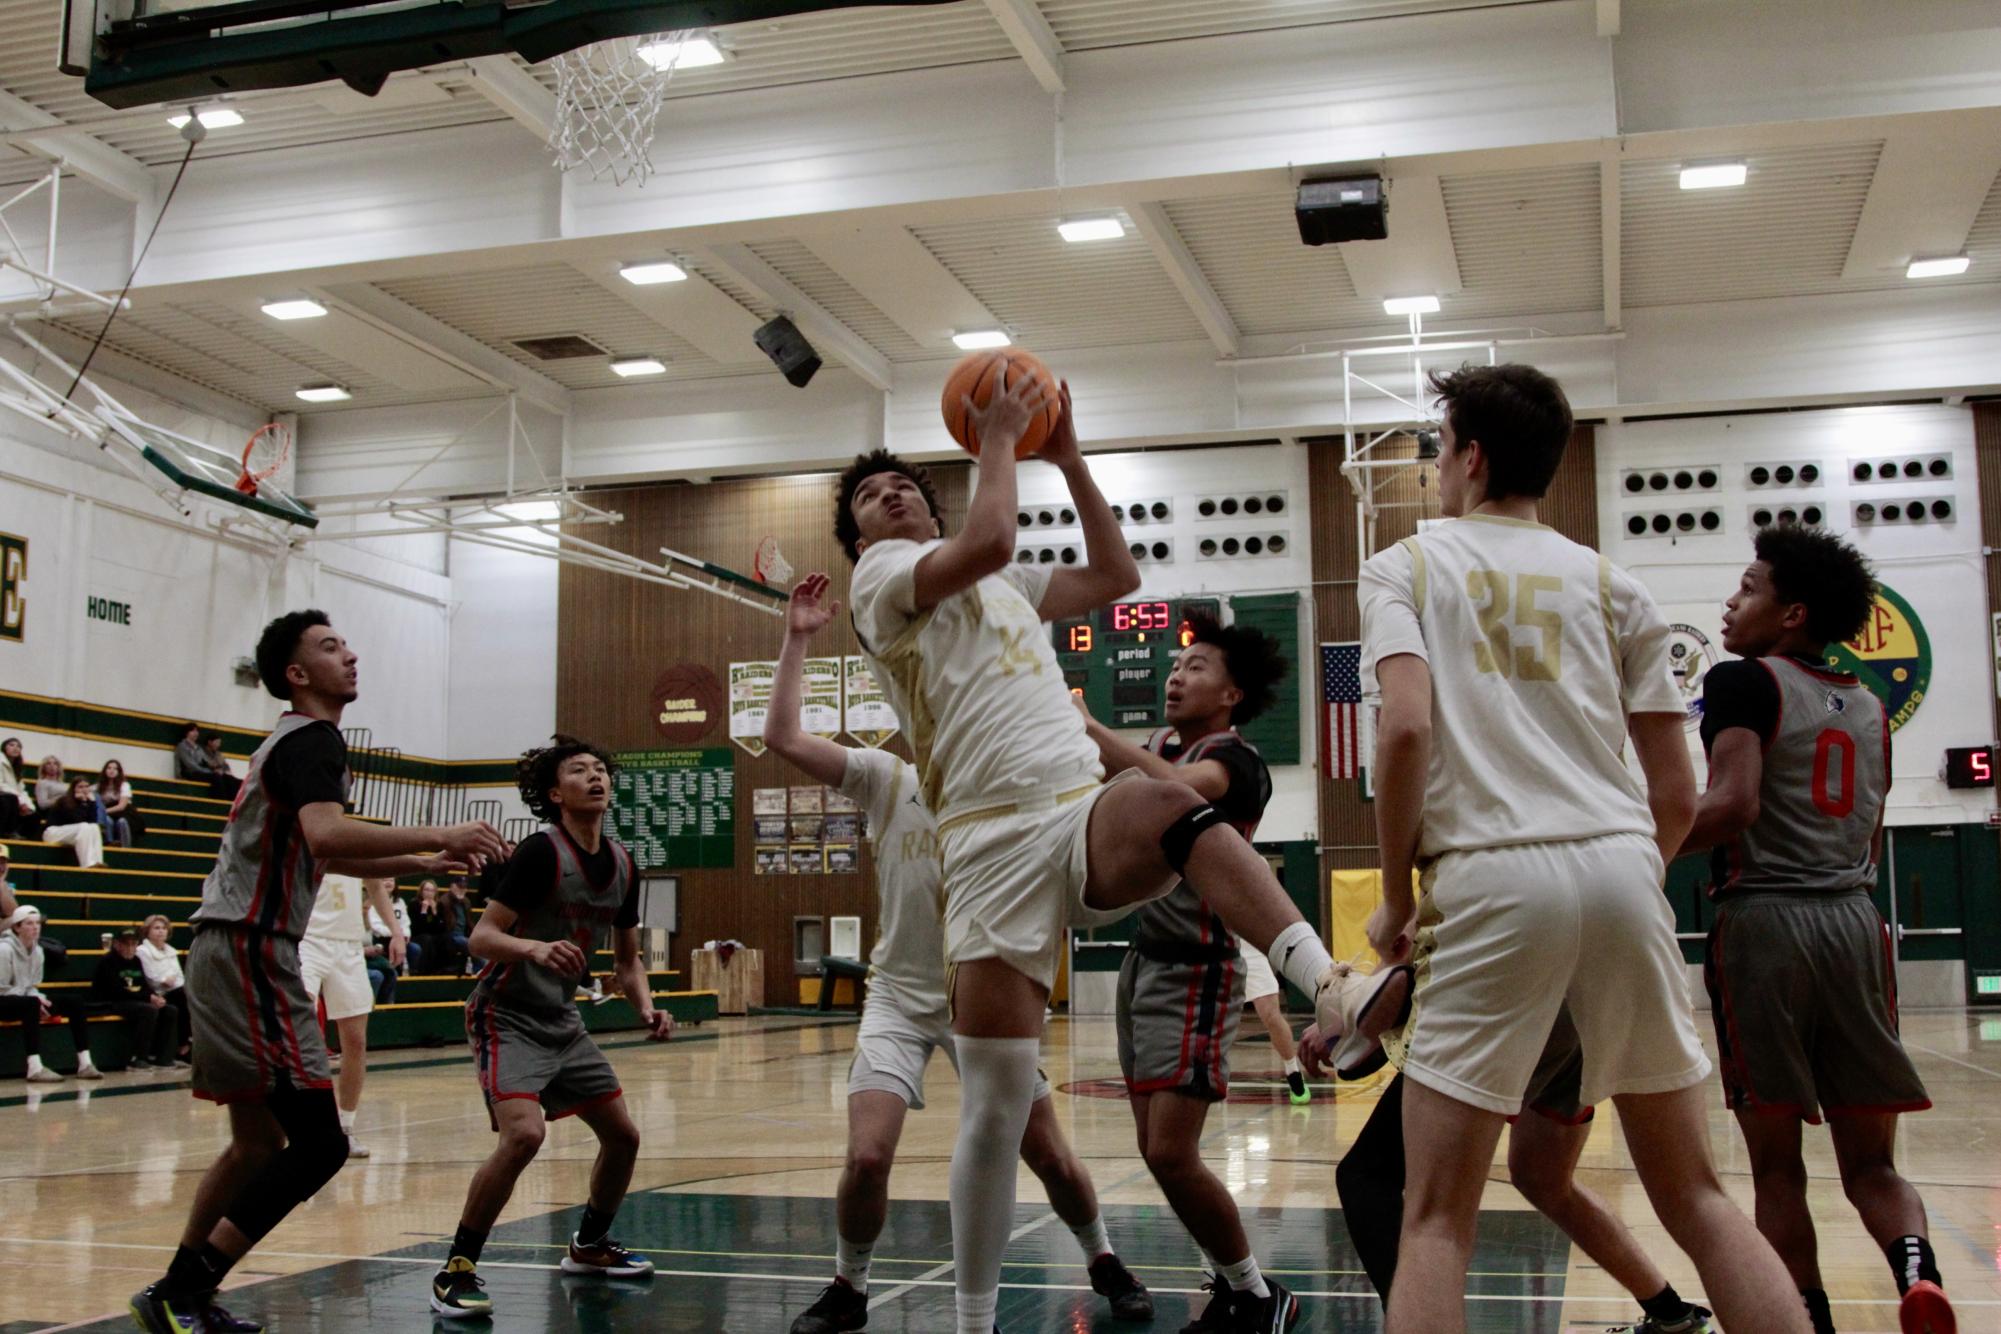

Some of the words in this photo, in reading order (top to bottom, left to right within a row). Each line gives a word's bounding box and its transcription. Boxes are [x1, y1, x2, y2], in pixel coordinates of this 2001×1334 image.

[88, 595, 131, 626] HOME
[1114, 603, 1169, 630] 6:53
[1070, 625, 1092, 651] 13
[1465, 569, 1562, 682] 35
[1118, 648, 1150, 661] period
[1119, 669, 1151, 681] player
[1122, 711, 1148, 724] game
[640, 759, 700, 768] BASKETBALL
[648, 751, 704, 760] CHAMPIONS
[1971, 752, 1990, 780] 5
[1811, 727, 1856, 819] 0
